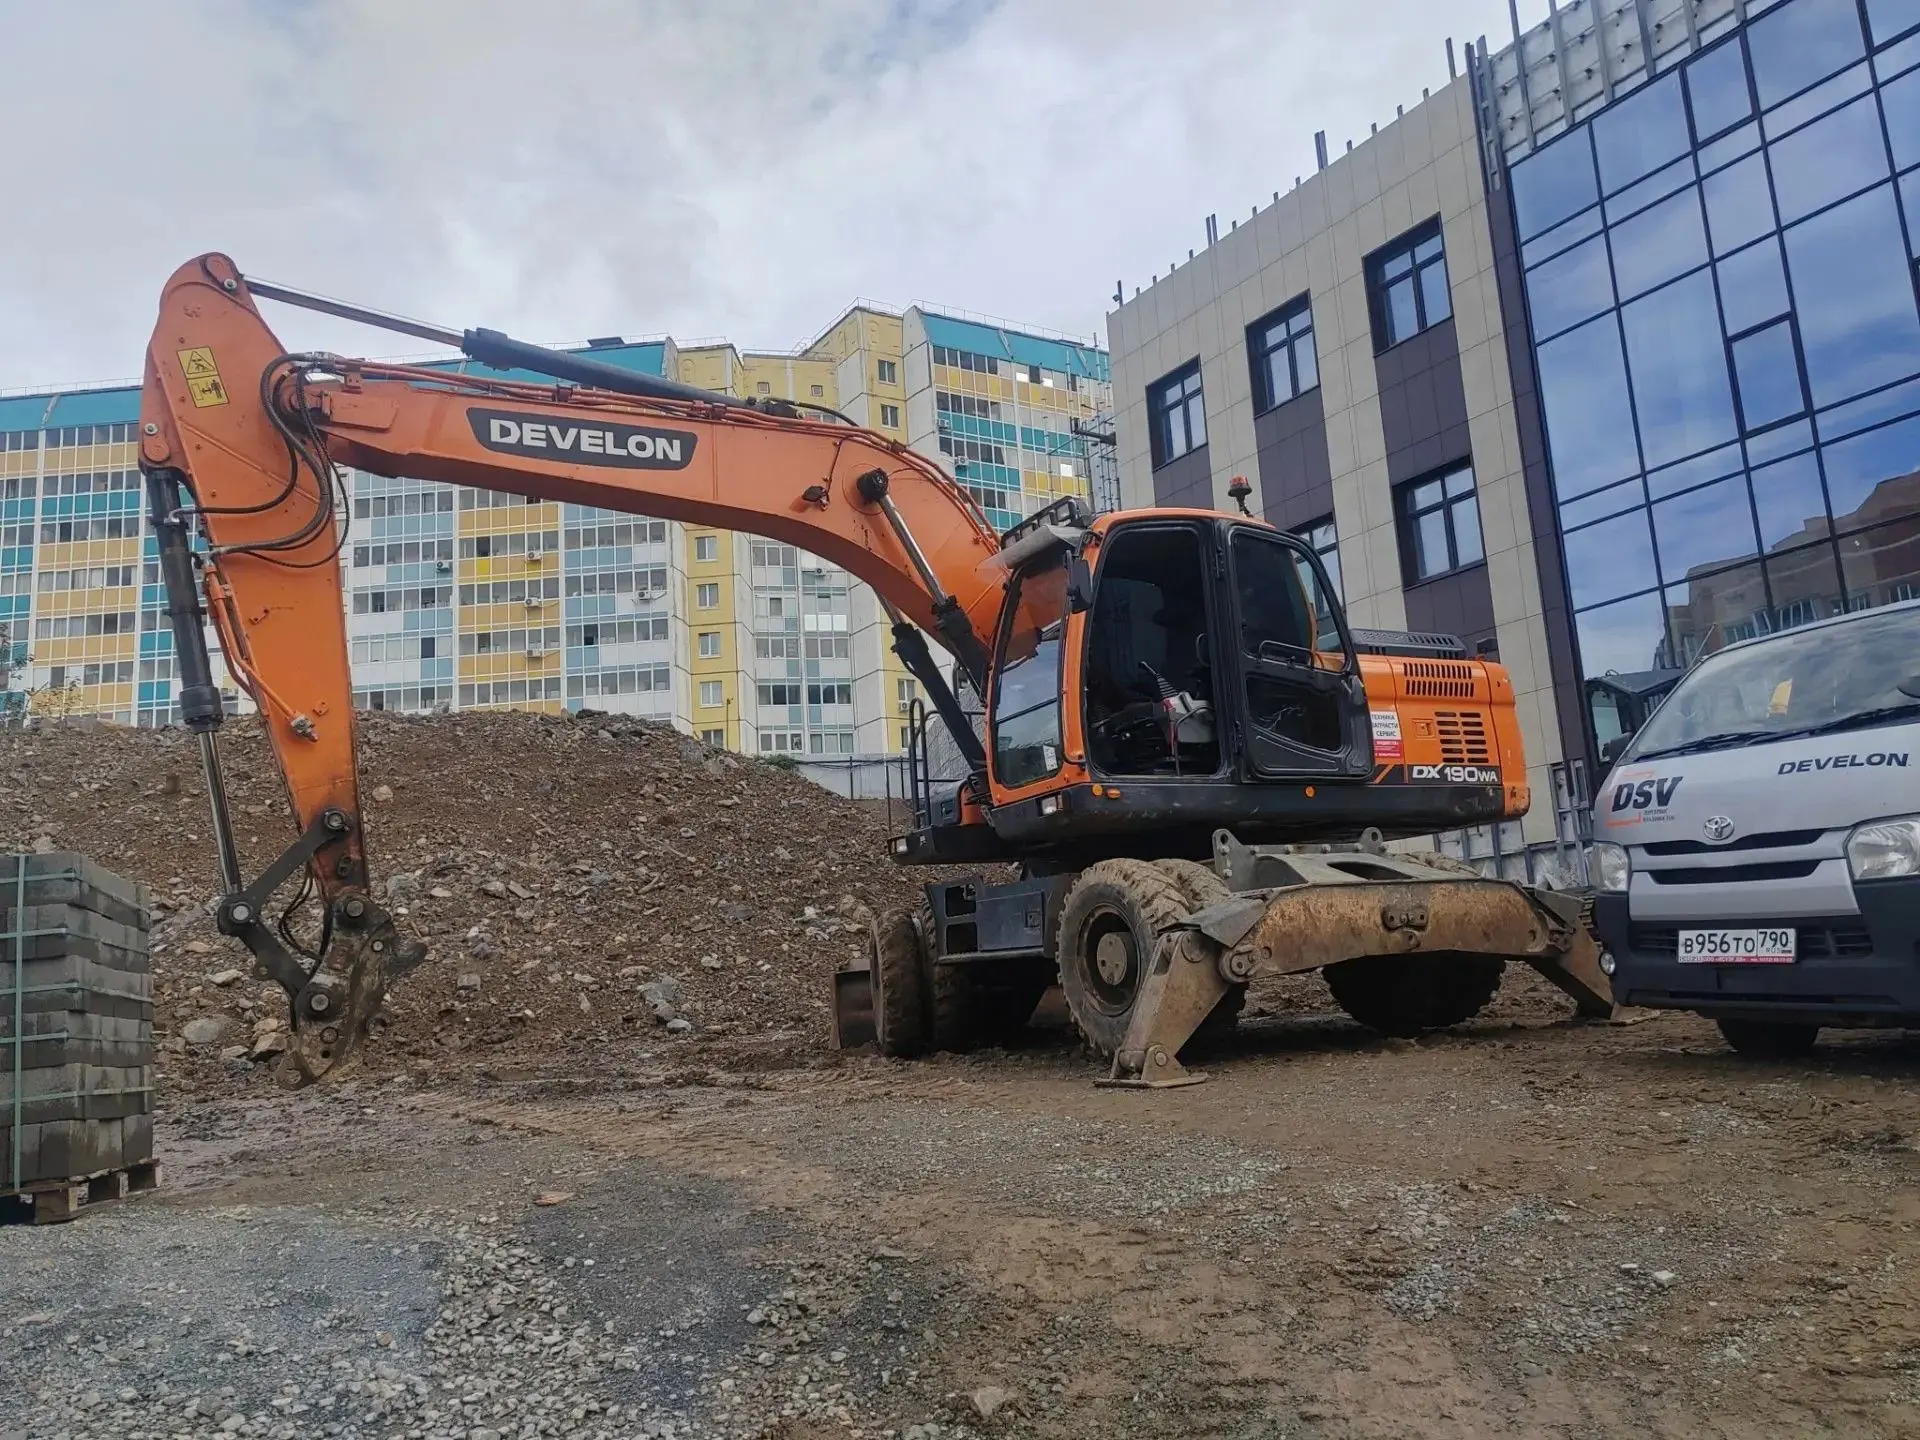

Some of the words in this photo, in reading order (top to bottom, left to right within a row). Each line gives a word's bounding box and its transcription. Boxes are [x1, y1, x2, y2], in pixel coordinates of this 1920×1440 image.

[489, 418, 682, 462] DEVELON
[1412, 764, 1442, 779] DX
[1778, 752, 1909, 775] DEVELON
[1611, 776, 1684, 812] DSV
[1759, 931, 1789, 948] 790
